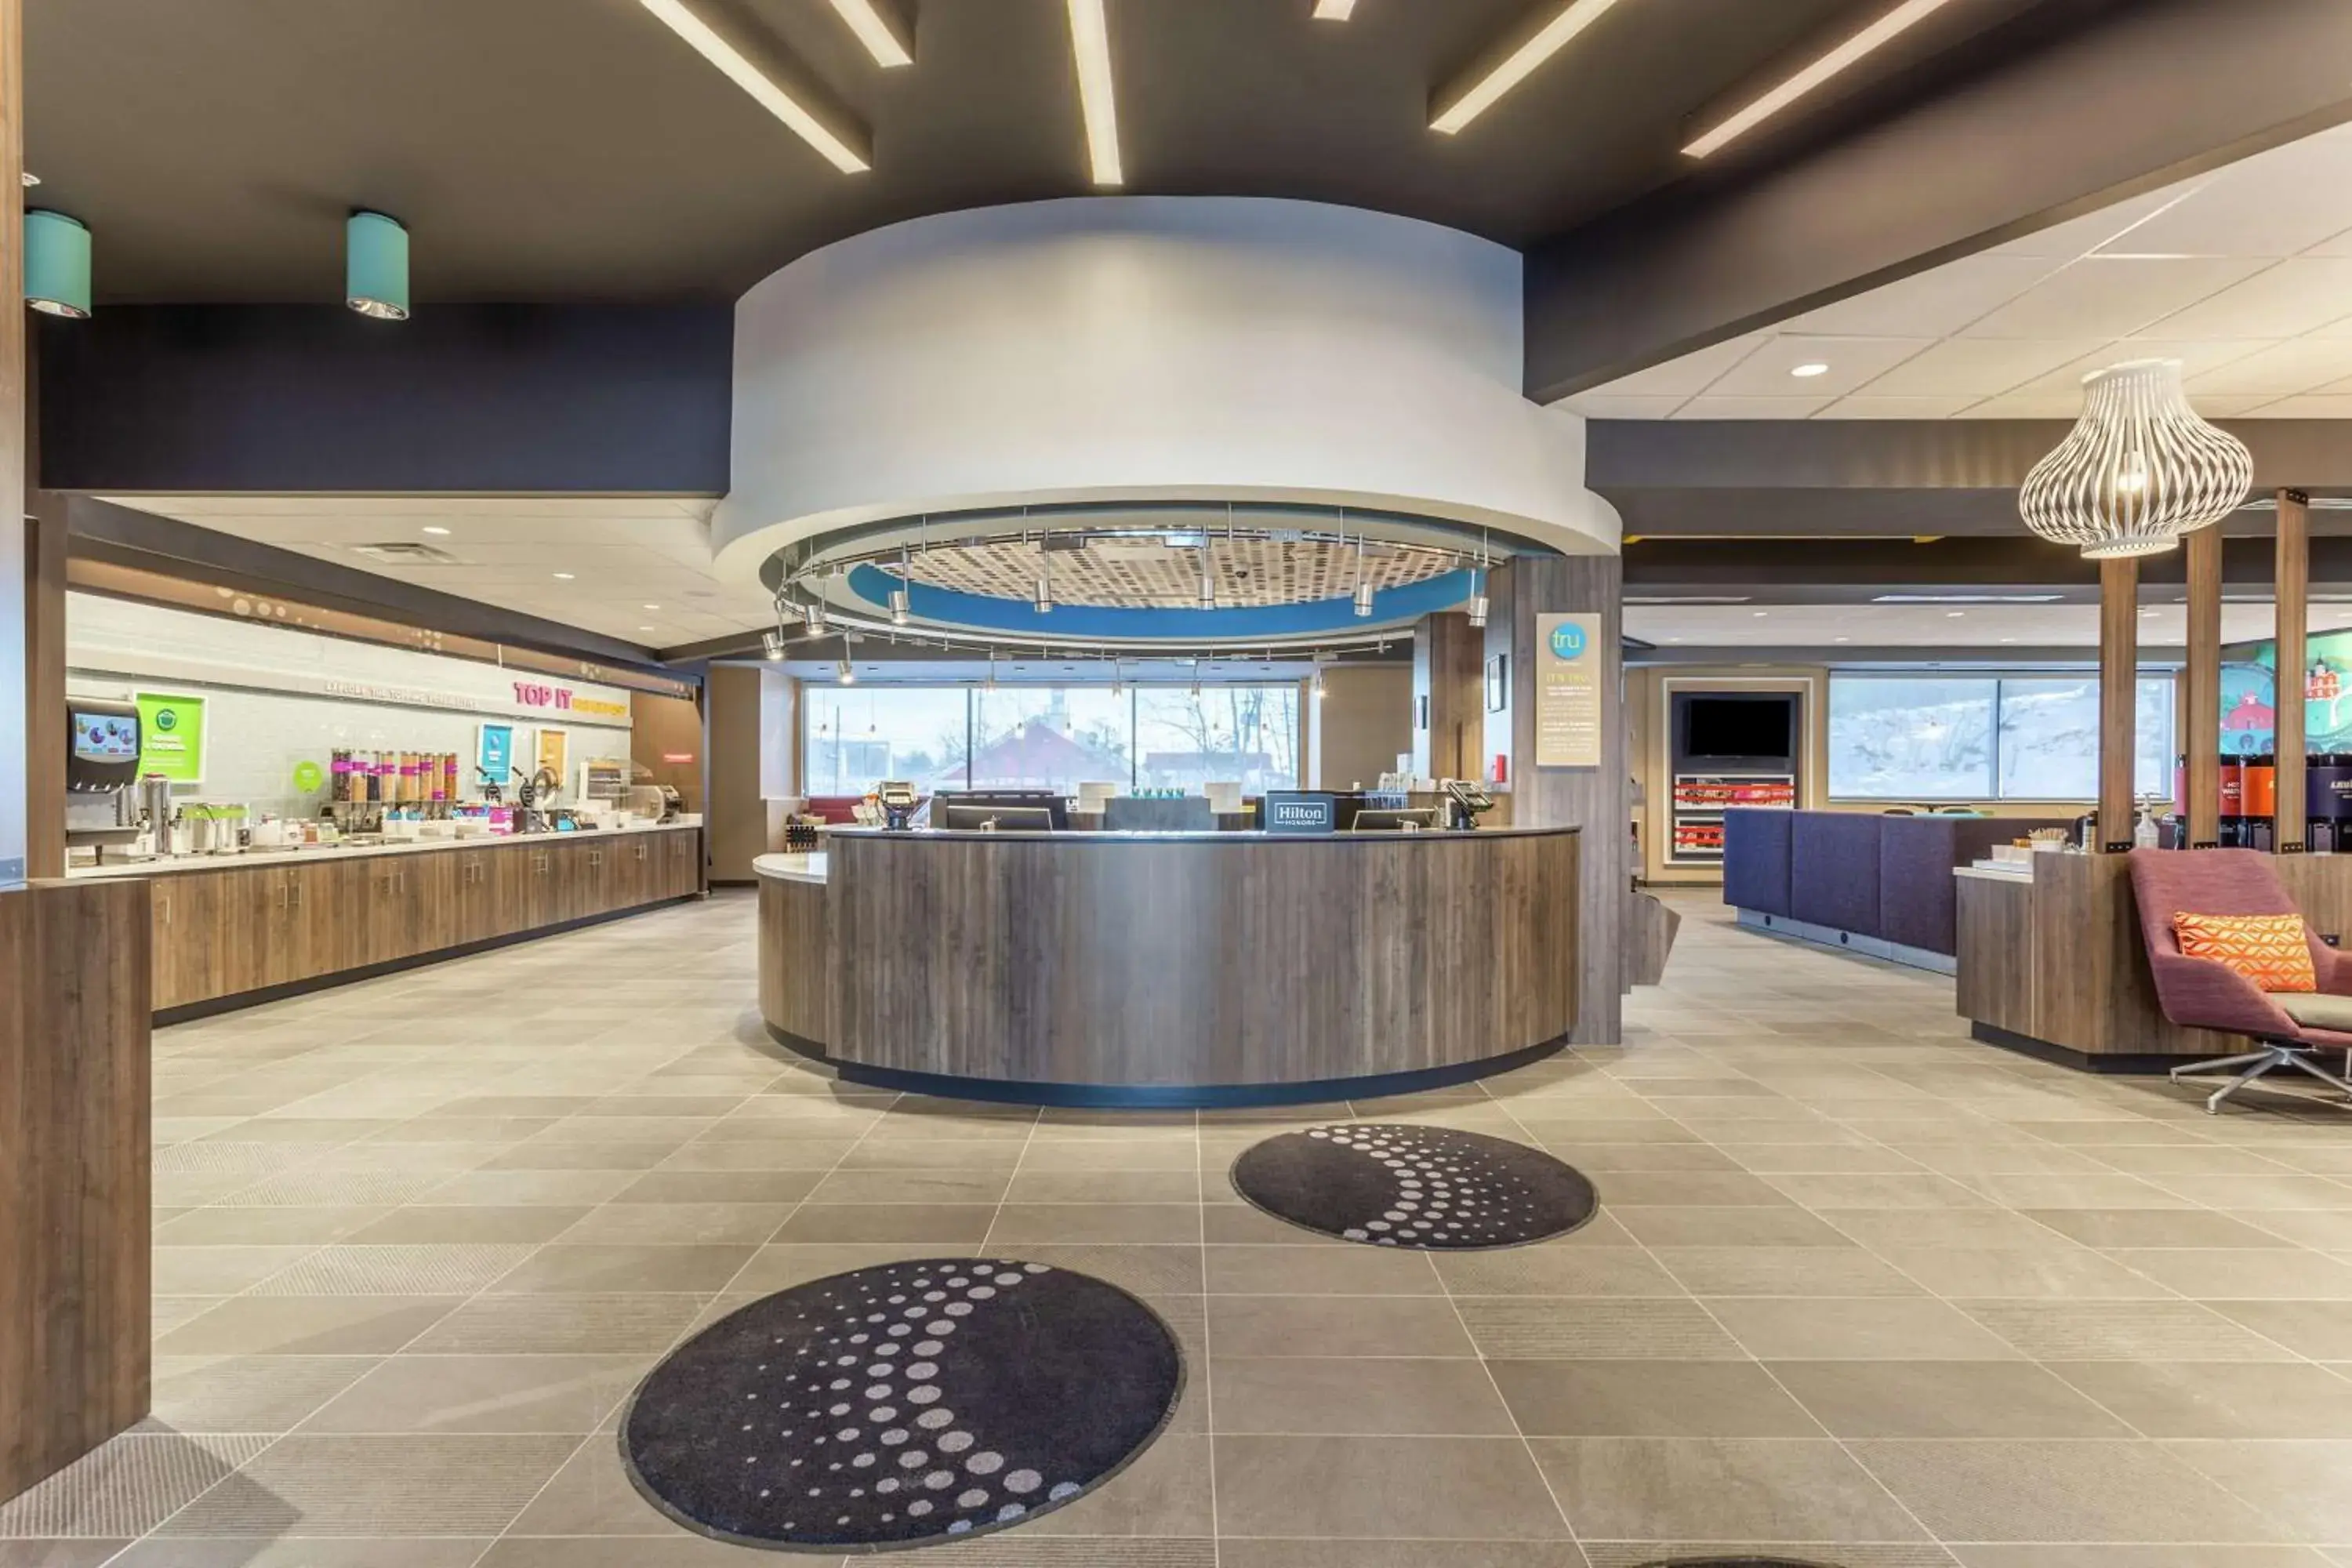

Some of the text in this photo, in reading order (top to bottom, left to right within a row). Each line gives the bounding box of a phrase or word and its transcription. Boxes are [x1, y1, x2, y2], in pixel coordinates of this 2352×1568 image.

[1552, 630, 1580, 648] tru
[514, 682, 552, 706] TOP
[555, 688, 572, 709] IT
[1279, 807, 1322, 818] Hilton
